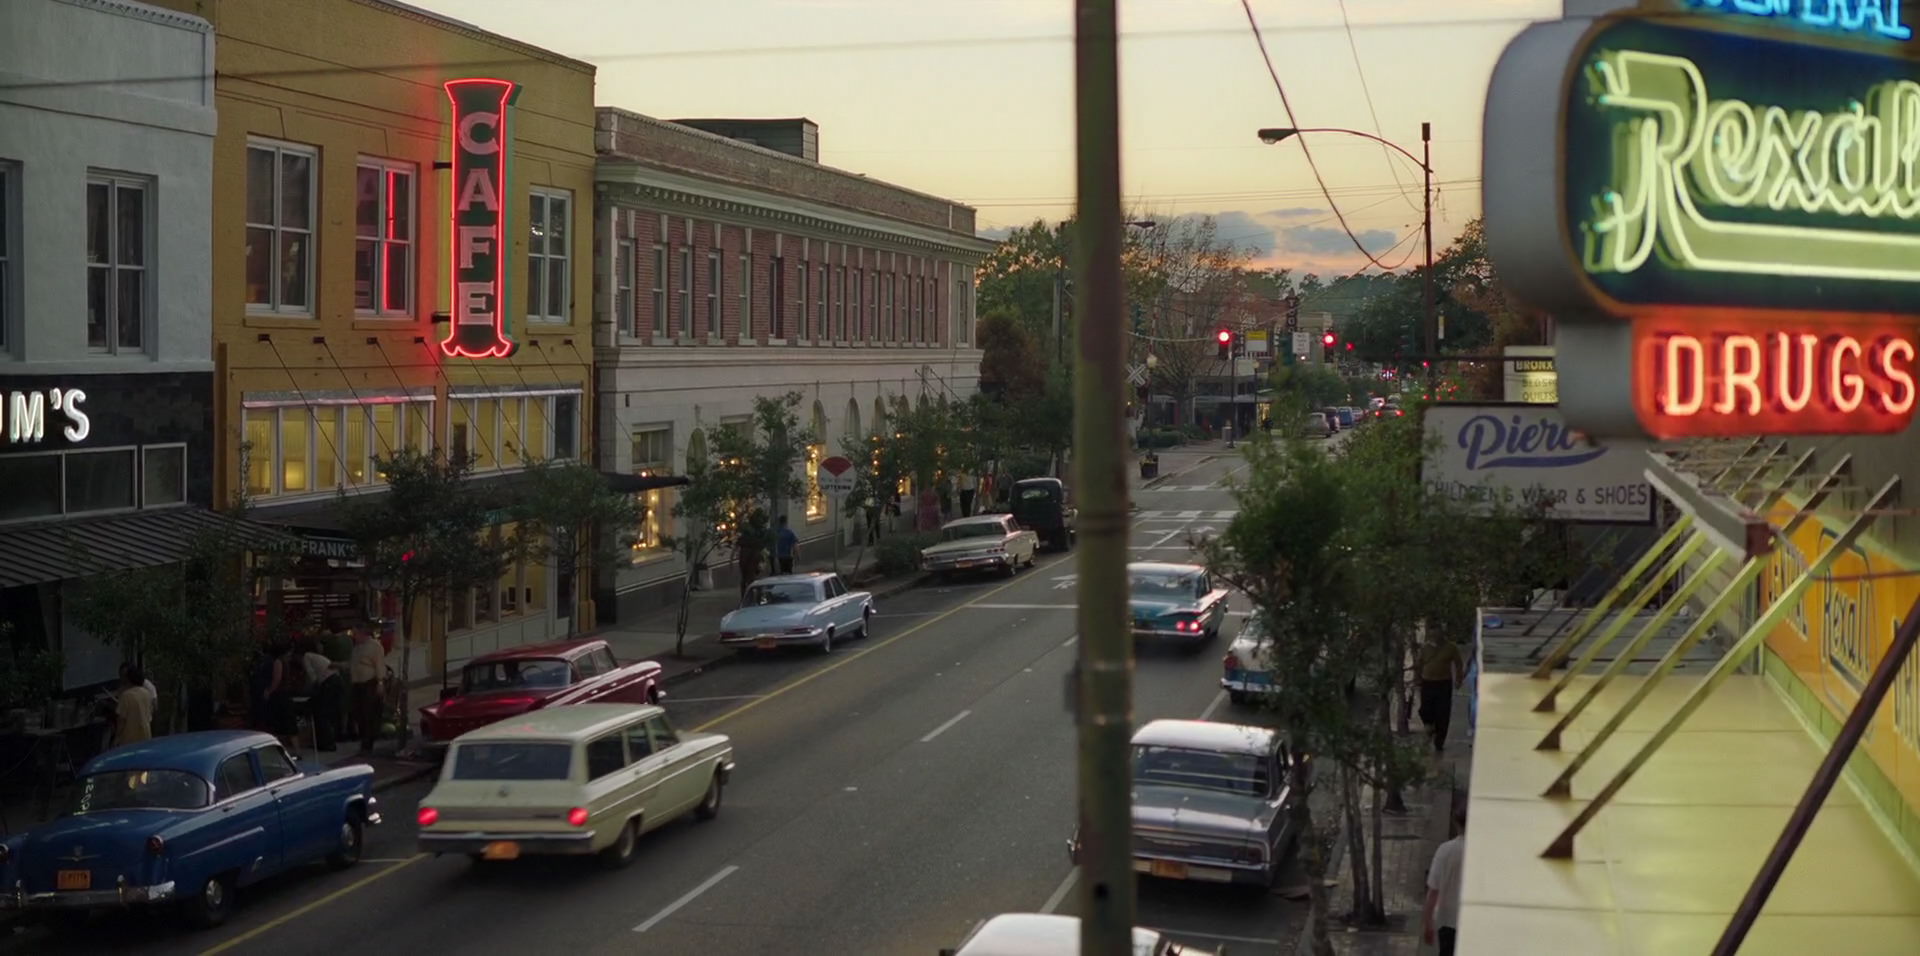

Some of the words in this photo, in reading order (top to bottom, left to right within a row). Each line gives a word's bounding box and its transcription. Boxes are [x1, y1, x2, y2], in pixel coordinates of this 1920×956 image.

[457, 112, 501, 329] CAFE
[1515, 360, 1554, 371] BRONX
[1659, 331, 1916, 417] DRUGS
[0, 387, 91, 443] M'S
[1425, 479, 1513, 504] CHILDRENS
[1575, 486, 1586, 505] &
[1594, 484, 1648, 506] SHOES
[301, 540, 359, 558] FRANK'S
